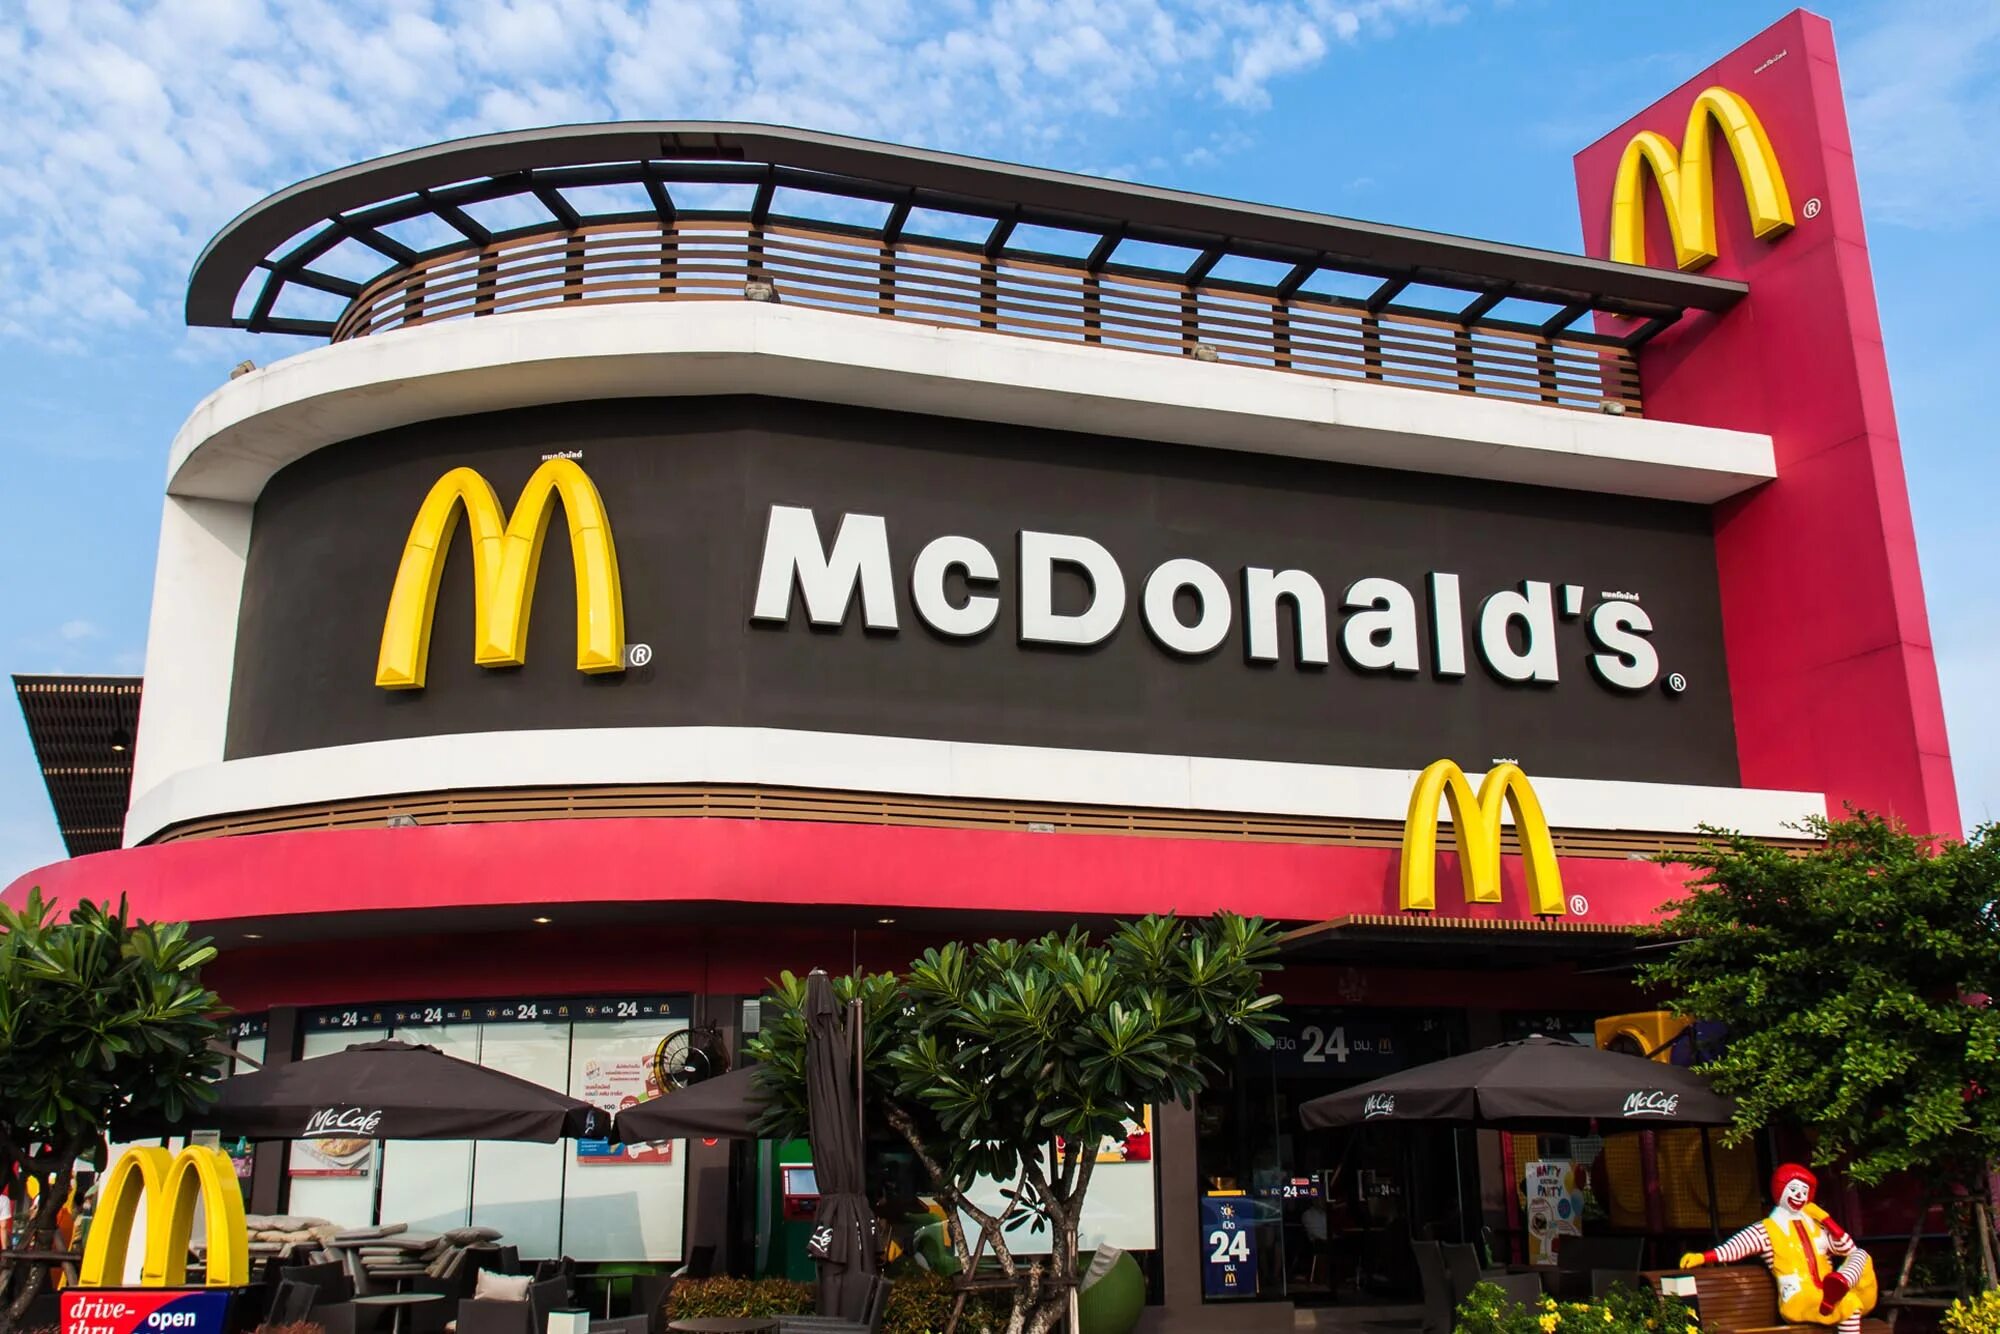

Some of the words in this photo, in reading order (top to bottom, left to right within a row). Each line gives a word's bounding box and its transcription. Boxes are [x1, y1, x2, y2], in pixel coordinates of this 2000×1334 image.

[750, 504, 1660, 692] McDonald's
[424, 1008, 443, 1023] 24
[517, 1004, 538, 1019] 24
[617, 1001, 638, 1017] 24
[342, 1011, 358, 1026] 24
[239, 1021, 250, 1036] 24
[1301, 1025, 1350, 1063] 24
[1283, 1186, 1298, 1198] 24
[1209, 1230, 1250, 1263] 24
[70, 1296, 136, 1319] drive-
[147, 1311, 196, 1331] open
